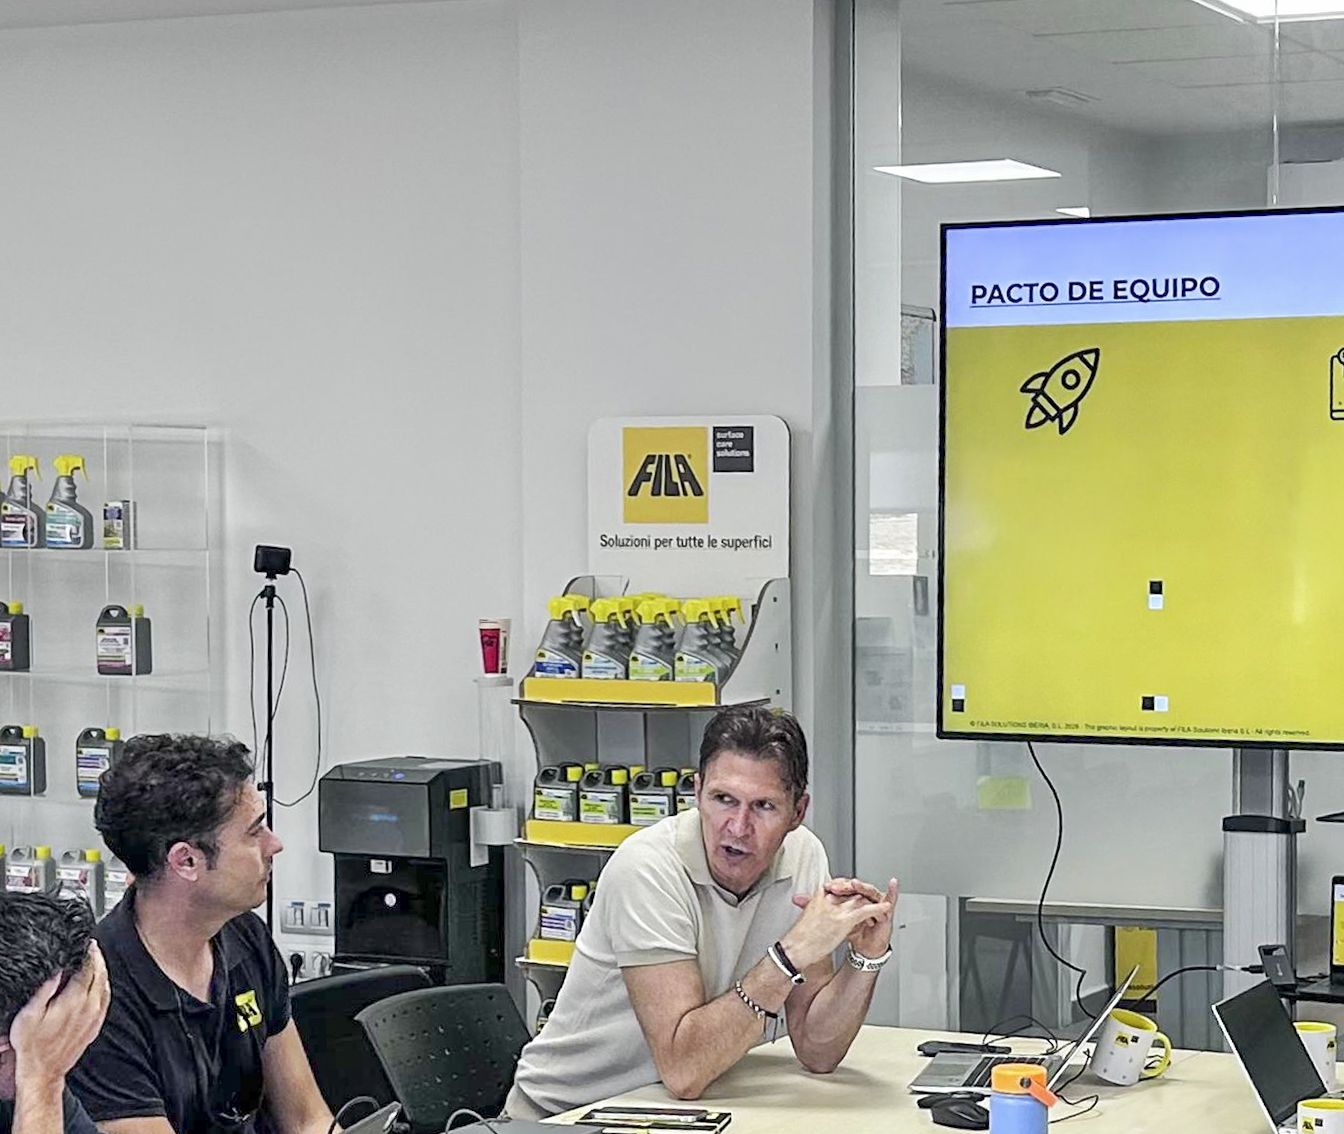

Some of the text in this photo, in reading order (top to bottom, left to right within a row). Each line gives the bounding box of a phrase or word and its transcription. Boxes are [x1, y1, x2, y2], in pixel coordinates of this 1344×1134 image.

[971, 276, 1221, 304] PACTO DE EQUIPO
[627, 454, 704, 496] FILA
[600, 534, 772, 550] Soluzioni per tutte le superfici
